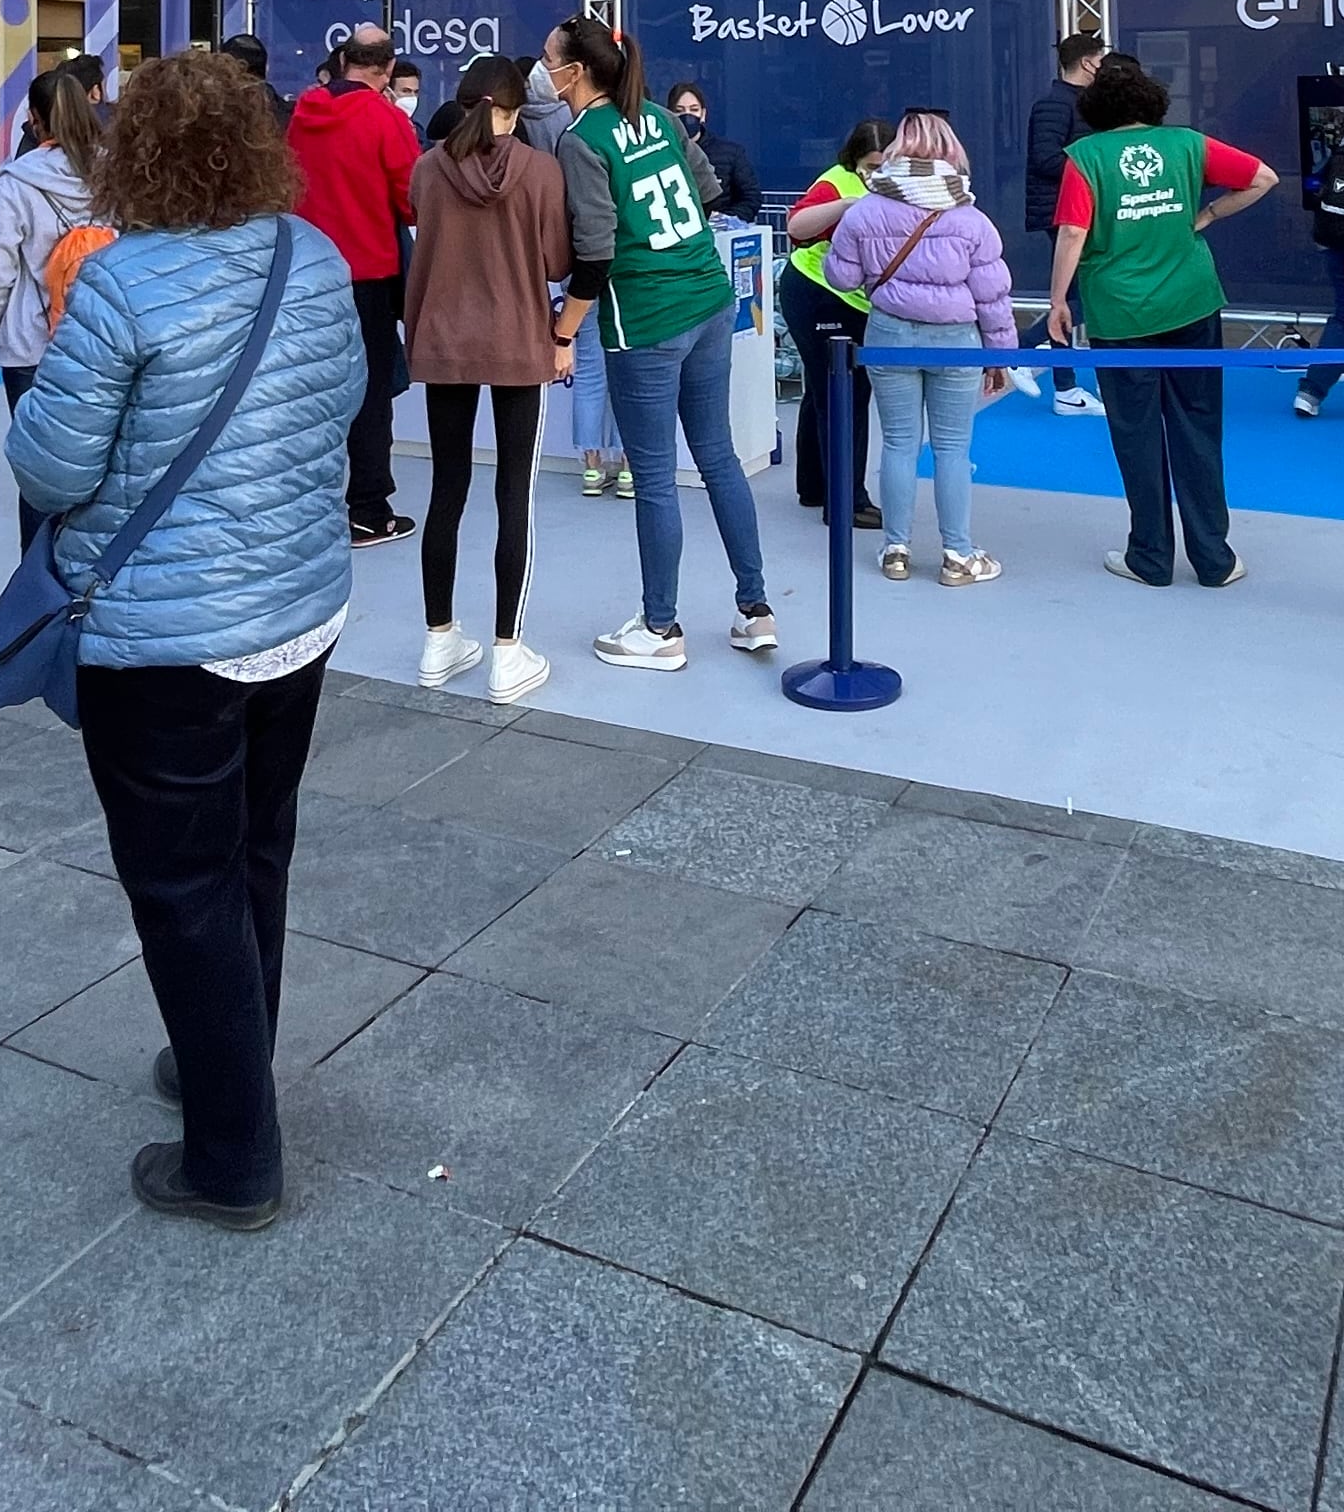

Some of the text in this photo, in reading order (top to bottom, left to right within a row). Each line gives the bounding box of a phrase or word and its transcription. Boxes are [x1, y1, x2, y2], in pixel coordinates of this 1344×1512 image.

[325, 9, 500, 55] edesa
[689, 0, 974, 41] Basket Lover
[632, 164, 704, 250] 33
[1117, 203, 1183, 220] Olympics
[1120, 188, 1174, 207] Special
